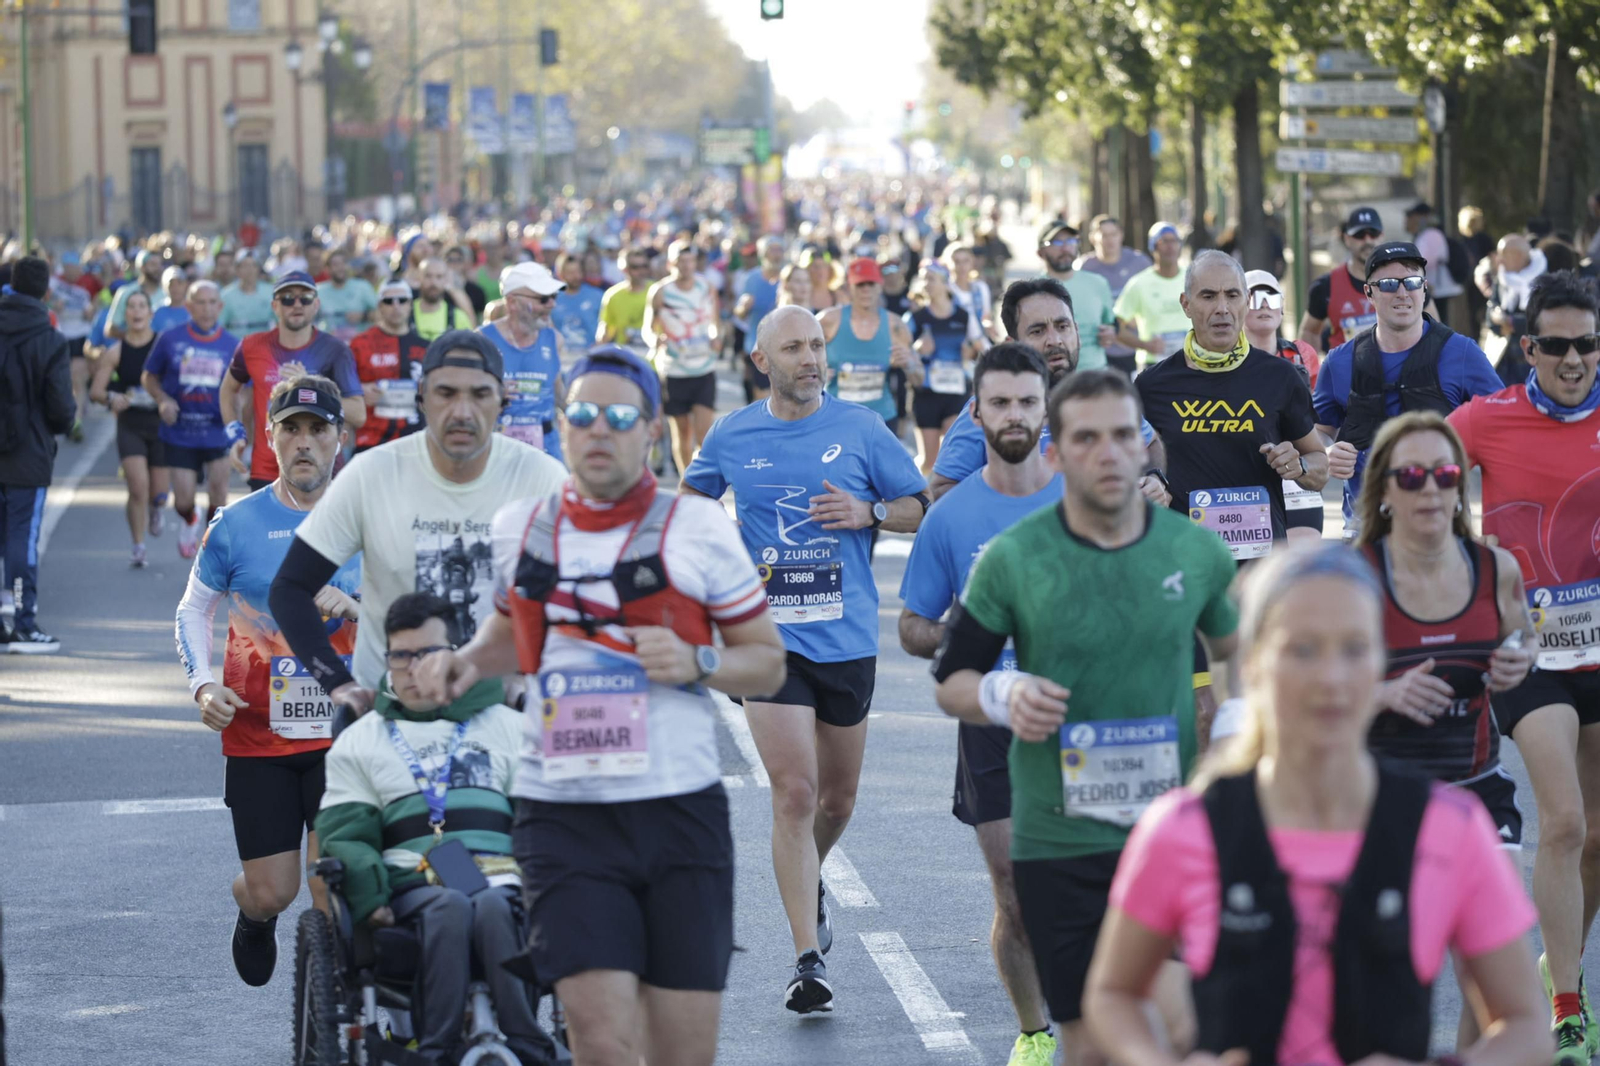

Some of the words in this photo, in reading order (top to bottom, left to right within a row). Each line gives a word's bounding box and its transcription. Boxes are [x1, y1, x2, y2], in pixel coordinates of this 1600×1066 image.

[1181, 419, 1254, 433] ULTRA
[1216, 491, 1260, 503] ZURICH
[412, 514, 450, 535] Ángel
[452, 521, 461, 535] y
[1218, 513, 1242, 524] 8480
[268, 530, 292, 540] GOBIK
[1218, 528, 1271, 543] AMMED
[784, 549, 831, 561] ZURICH
[783, 572, 815, 584] 13669
[804, 591, 842, 605] MORAIS
[1558, 611, 1592, 627] 10566
[571, 675, 635, 692] ZURICH
[301, 686, 329, 697] 1119
[552, 726, 632, 751] BERNAR
[1102, 723, 1166, 743] ZURICH
[1066, 782, 1129, 804] PEDRO
